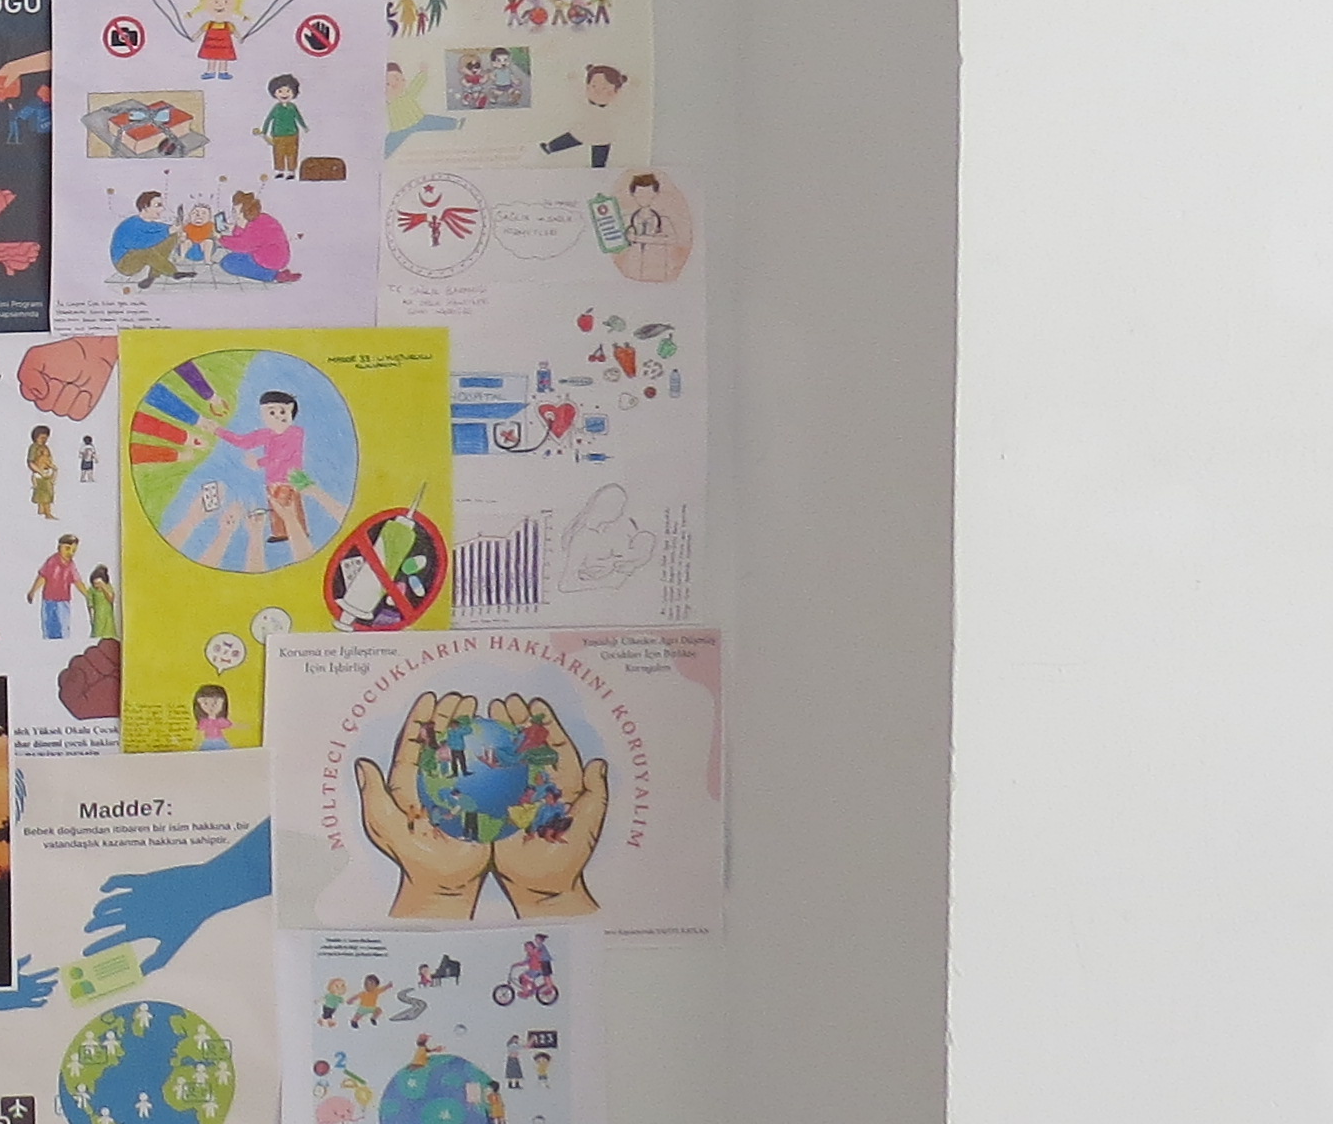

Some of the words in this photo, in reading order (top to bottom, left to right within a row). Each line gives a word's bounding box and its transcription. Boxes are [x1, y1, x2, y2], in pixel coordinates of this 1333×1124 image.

[342, 635, 479, 733] ÇOCUKLARIN
[488, 635, 614, 702] HAKLARINI
[611, 703, 651, 851] KORUYALIM
[79, 799, 172, 819] Madde7:
